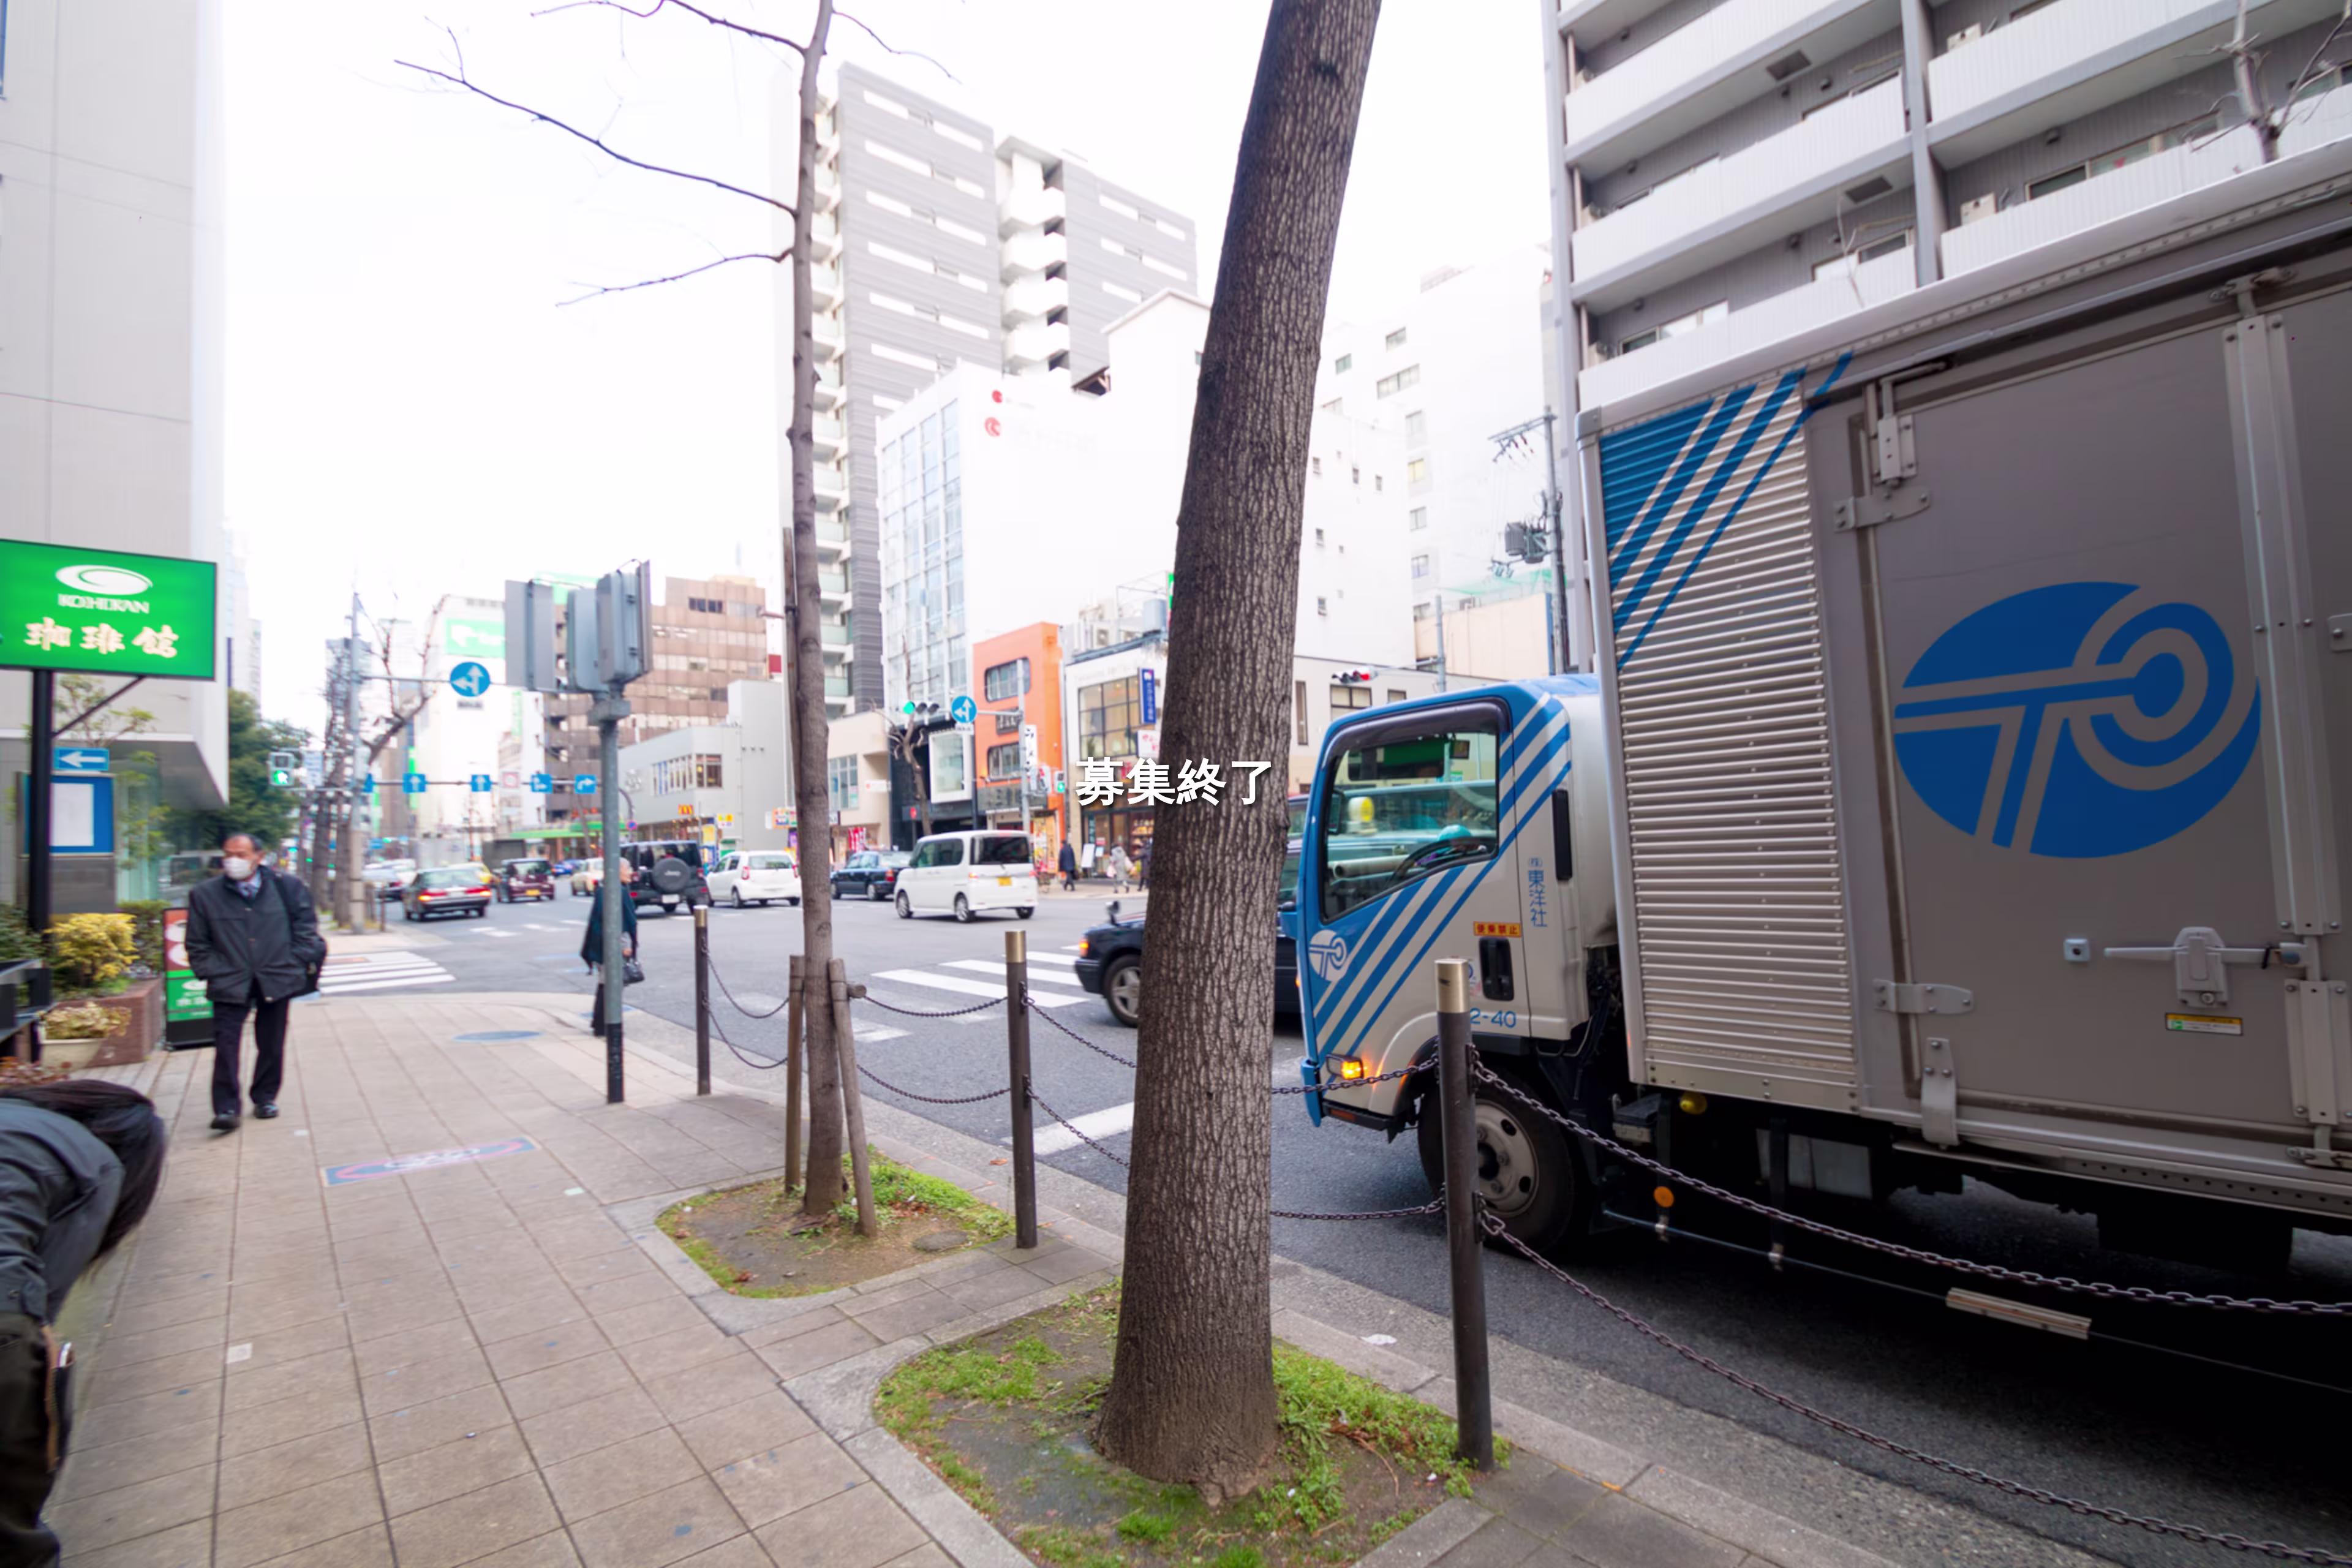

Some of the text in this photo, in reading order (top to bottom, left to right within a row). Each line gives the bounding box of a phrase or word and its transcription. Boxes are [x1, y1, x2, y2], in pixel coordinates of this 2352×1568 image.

[58, 593, 150, 614] KOHIKAN
[23, 616, 179, 658] 珈琲館
